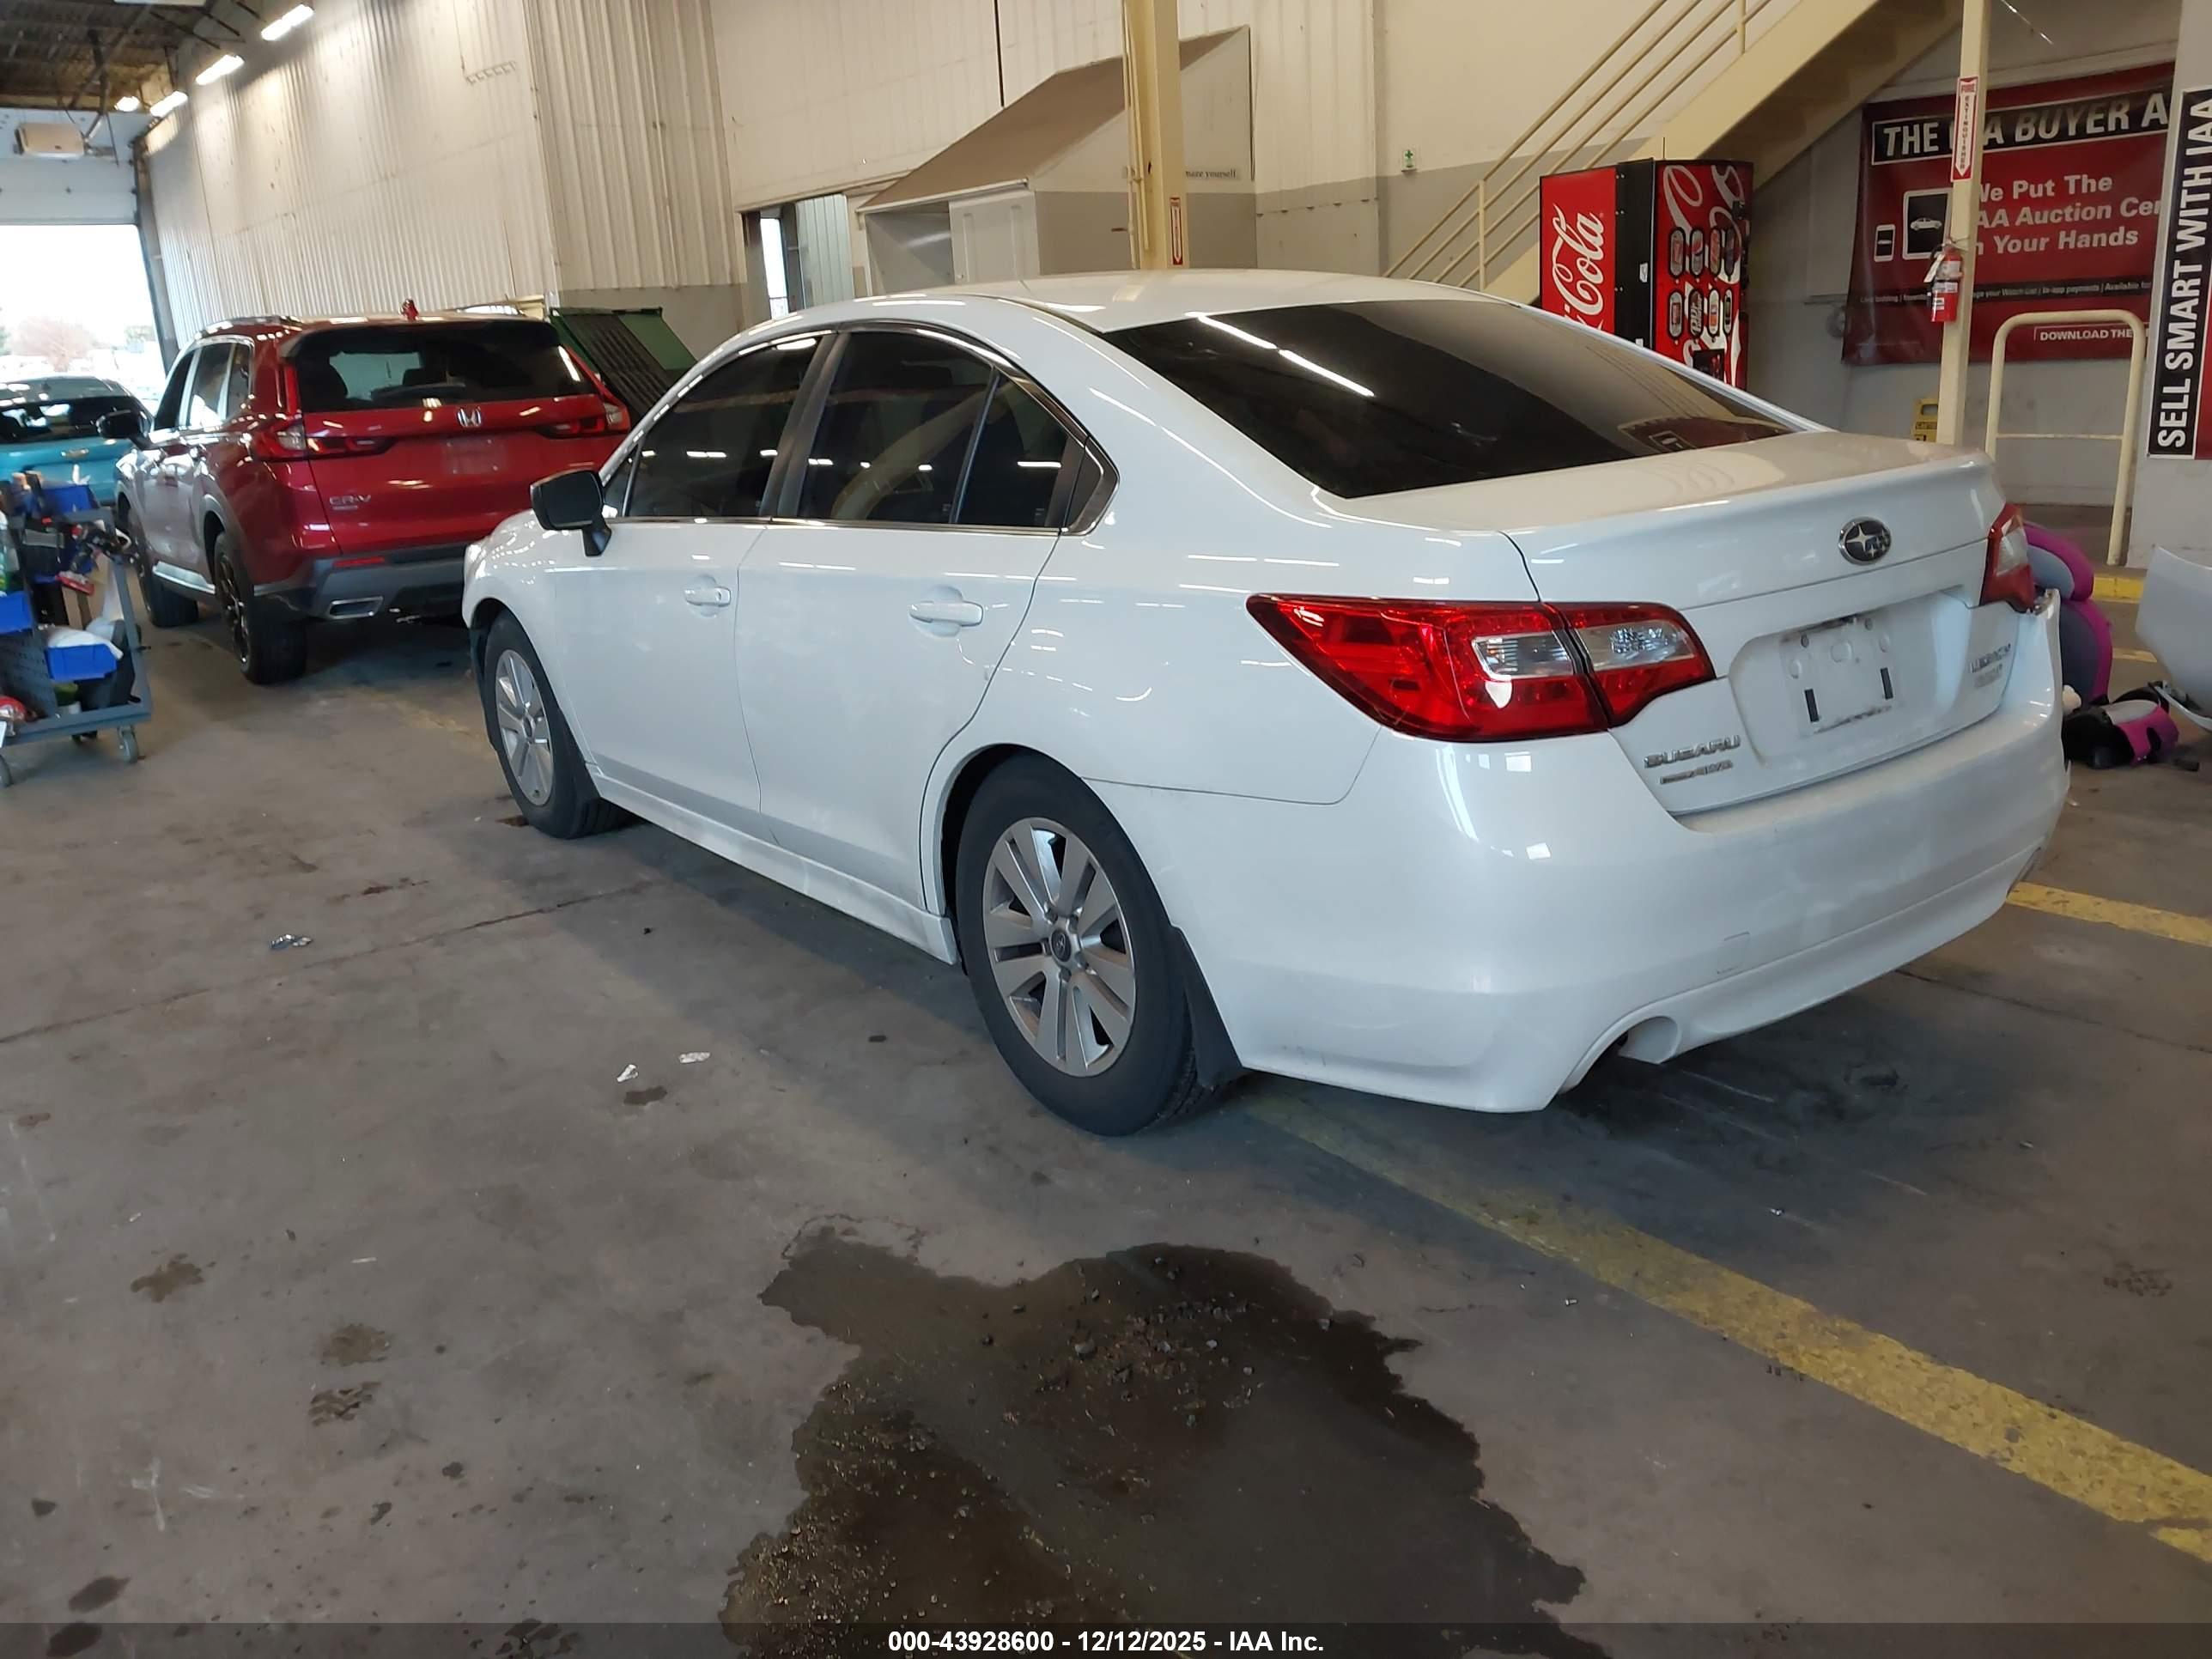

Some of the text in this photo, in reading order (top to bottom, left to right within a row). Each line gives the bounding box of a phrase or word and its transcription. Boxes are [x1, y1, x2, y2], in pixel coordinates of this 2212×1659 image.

[1883, 122, 1939, 156] THE
[2014, 100, 2130, 143] BUYER
[2013, 179, 2056, 199] Put
[2064, 174, 2112, 195] The
[2015, 203, 2112, 227] Auction
[1993, 235, 2050, 254] Your
[2058, 226, 2139, 250] Hands
[2157, 97, 2212, 447] SELL SMART WITH IAA
[2039, 329, 2133, 341] DOWNLOAD THE
[1644, 735, 1741, 769] SUBARU
